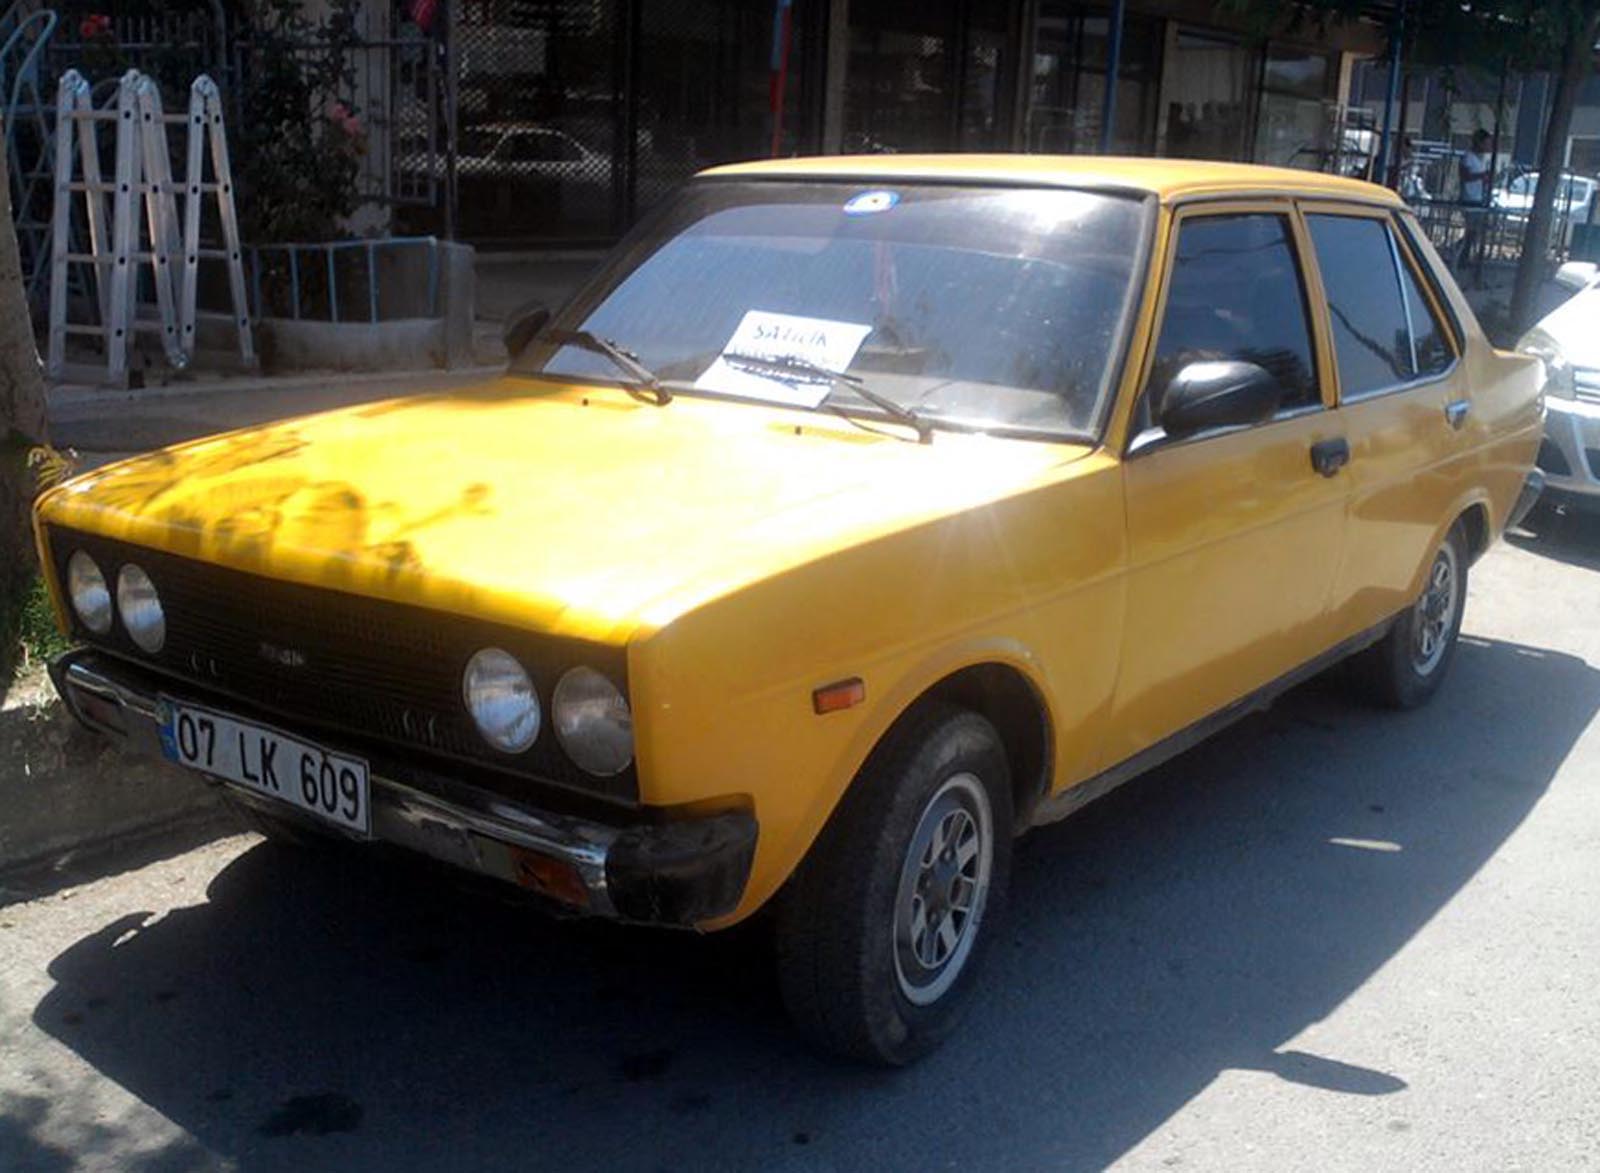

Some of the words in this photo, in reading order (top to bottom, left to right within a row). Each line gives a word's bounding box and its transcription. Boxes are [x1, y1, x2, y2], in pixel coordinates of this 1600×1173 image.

[178, 713, 216, 766] 07
[239, 731, 280, 791] LK
[301, 752, 360, 821] 609
